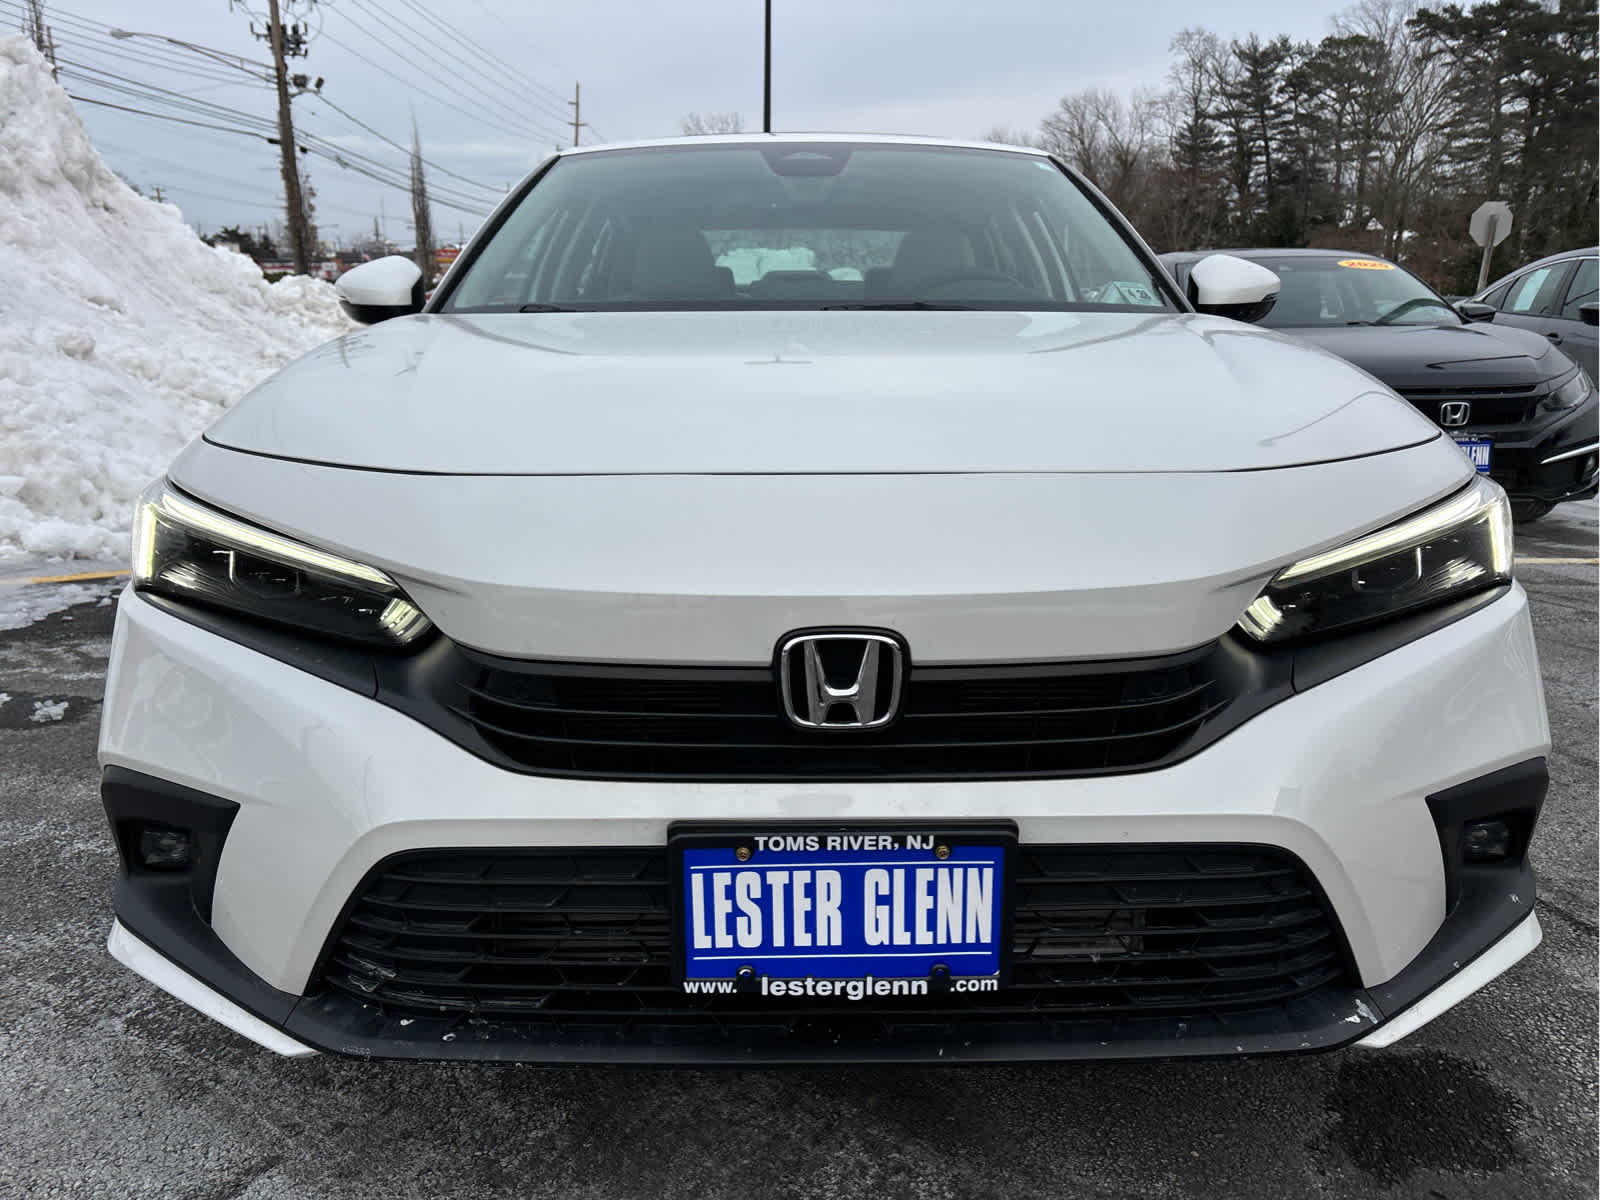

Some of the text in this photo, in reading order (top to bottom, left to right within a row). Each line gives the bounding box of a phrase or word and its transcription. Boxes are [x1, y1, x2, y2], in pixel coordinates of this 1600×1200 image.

[755, 835, 935, 851] TOMS RIVER, NJ
[691, 867, 994, 949] LESTER GLENN
[683, 976, 998, 1000] www. lesterglenn .com
